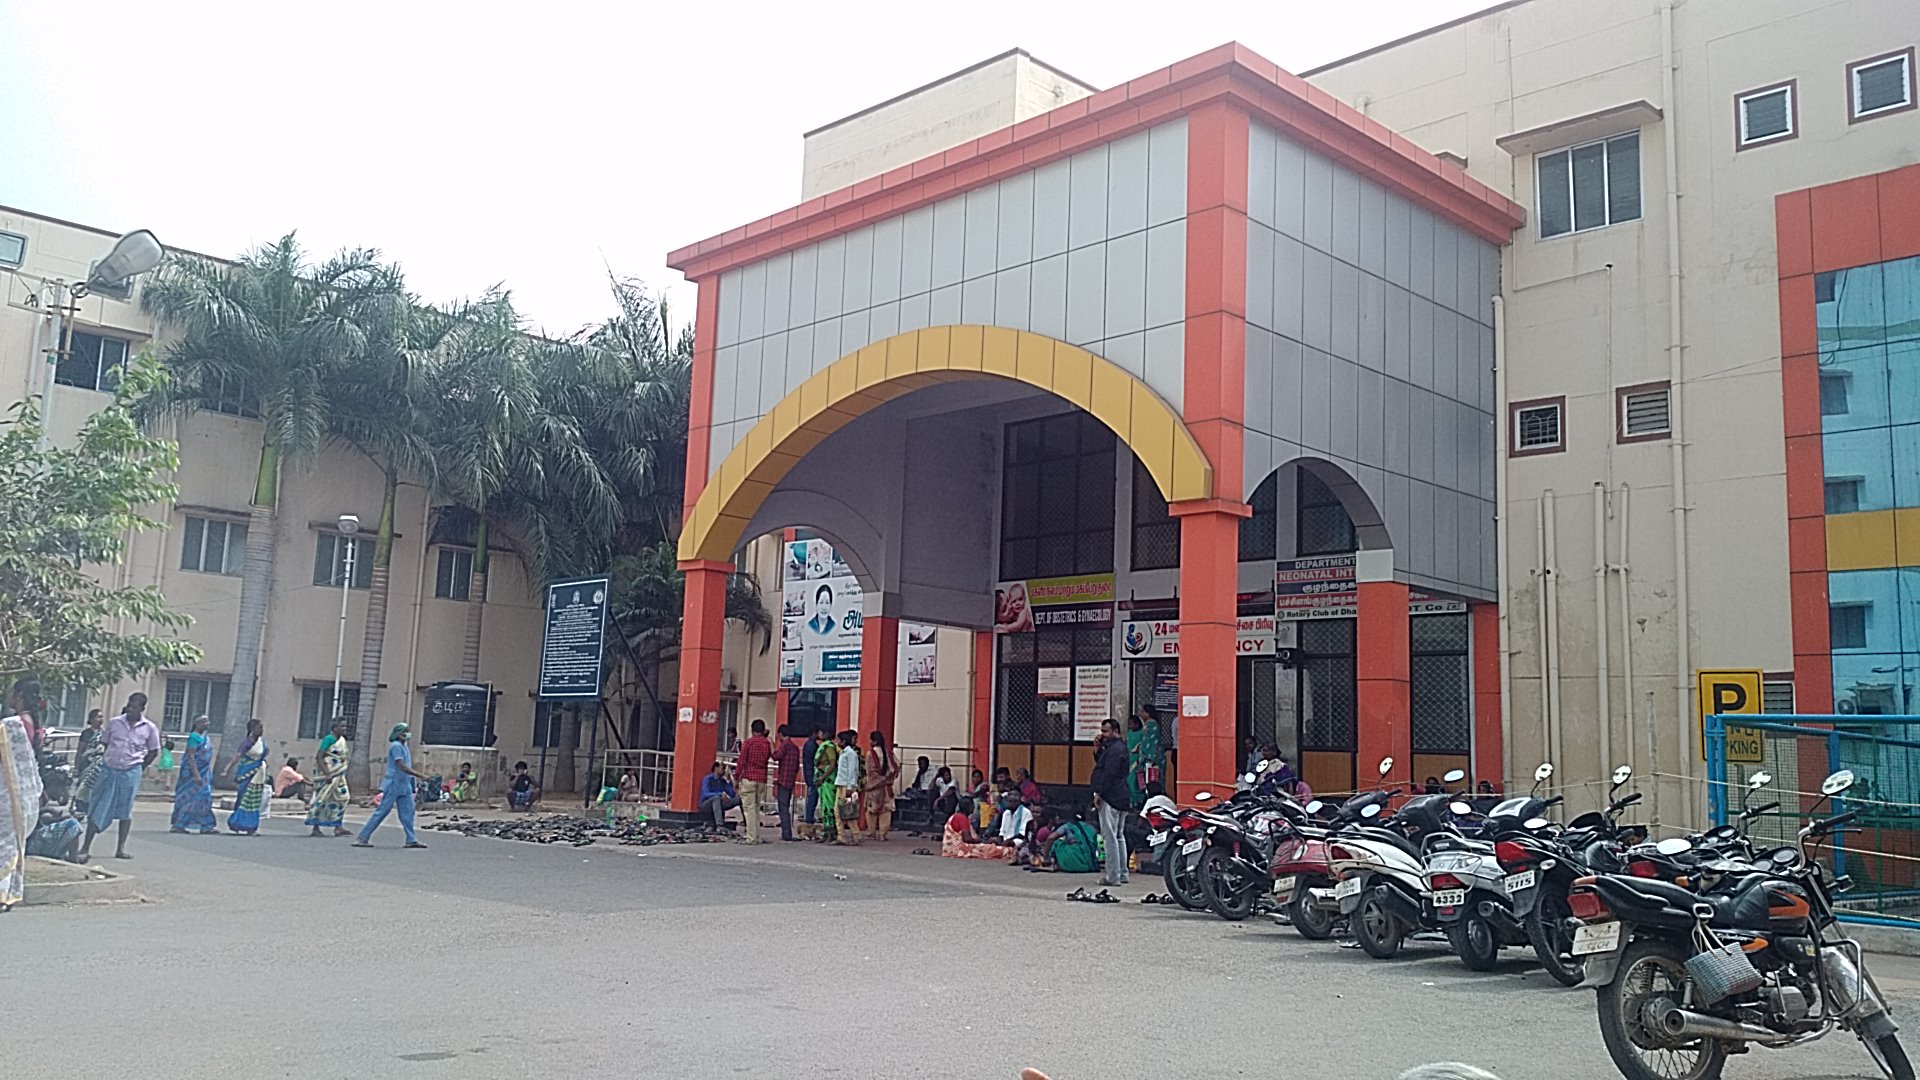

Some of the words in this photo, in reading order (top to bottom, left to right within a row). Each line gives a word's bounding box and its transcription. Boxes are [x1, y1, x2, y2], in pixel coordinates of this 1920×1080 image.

[1279, 569, 1334, 581] NEONATAL
[1335, 567, 1357, 578] INT
[1302, 581, 1356, 594] குழந்தைக
[1047, 612, 1052, 623] OF
[1286, 610, 1311, 618] Rotary
[1312, 609, 1329, 617] Club
[1341, 607, 1357, 615] Dha
[1154, 622, 1168, 637] 24
[1713, 683, 1746, 715] P
[1507, 877, 1532, 891] 5115
[1435, 894, 1463, 905] 4332
